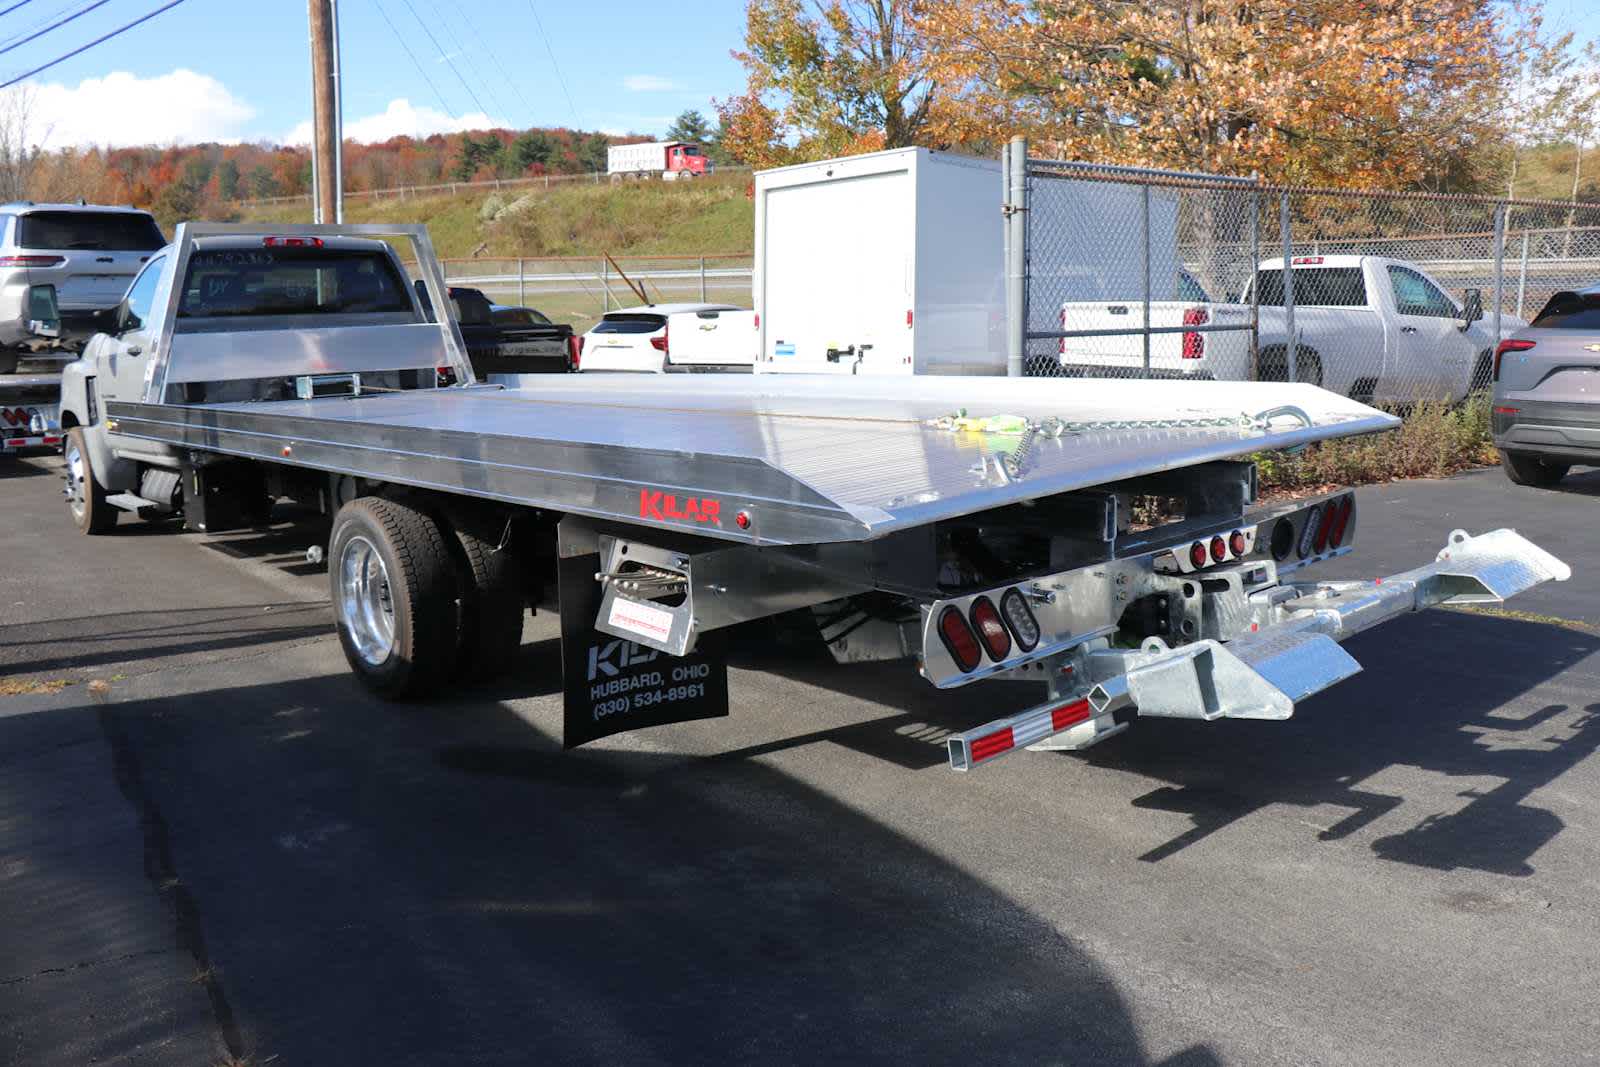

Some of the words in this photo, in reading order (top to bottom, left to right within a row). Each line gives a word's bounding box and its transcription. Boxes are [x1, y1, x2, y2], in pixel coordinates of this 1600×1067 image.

[640, 488, 720, 524] KILAR
[590, 671, 665, 701] HUBBARD,
[672, 663, 710, 681] OHIO
[594, 696, 630, 721] (330)
[634, 683, 705, 708] 534-8961
